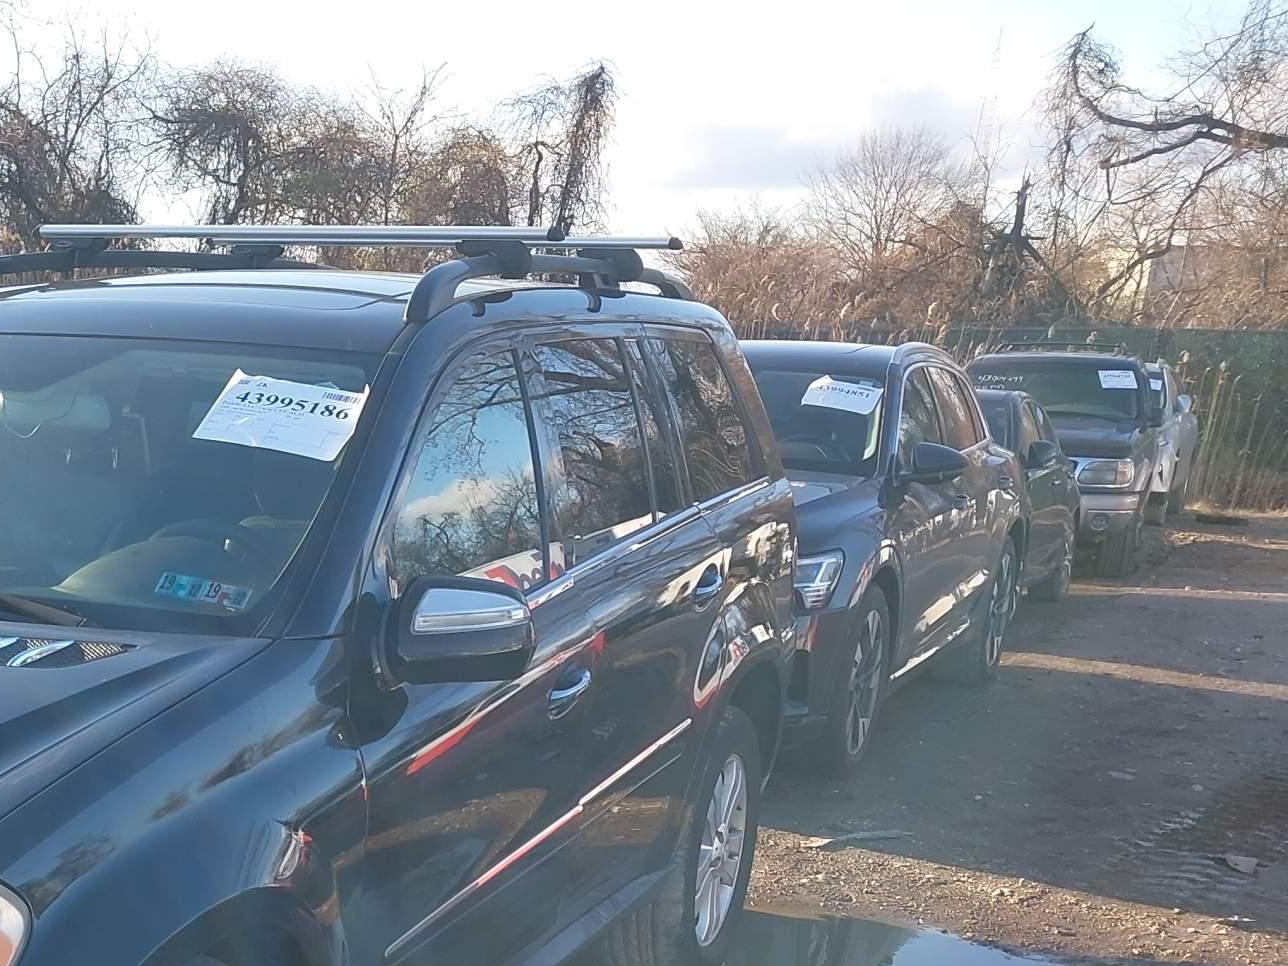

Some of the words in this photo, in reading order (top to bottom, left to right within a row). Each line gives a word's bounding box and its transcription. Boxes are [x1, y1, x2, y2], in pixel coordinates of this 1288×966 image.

[235, 390, 350, 421] 43995186
[159, 574, 177, 590] 19
[204, 581, 222, 600] 19
